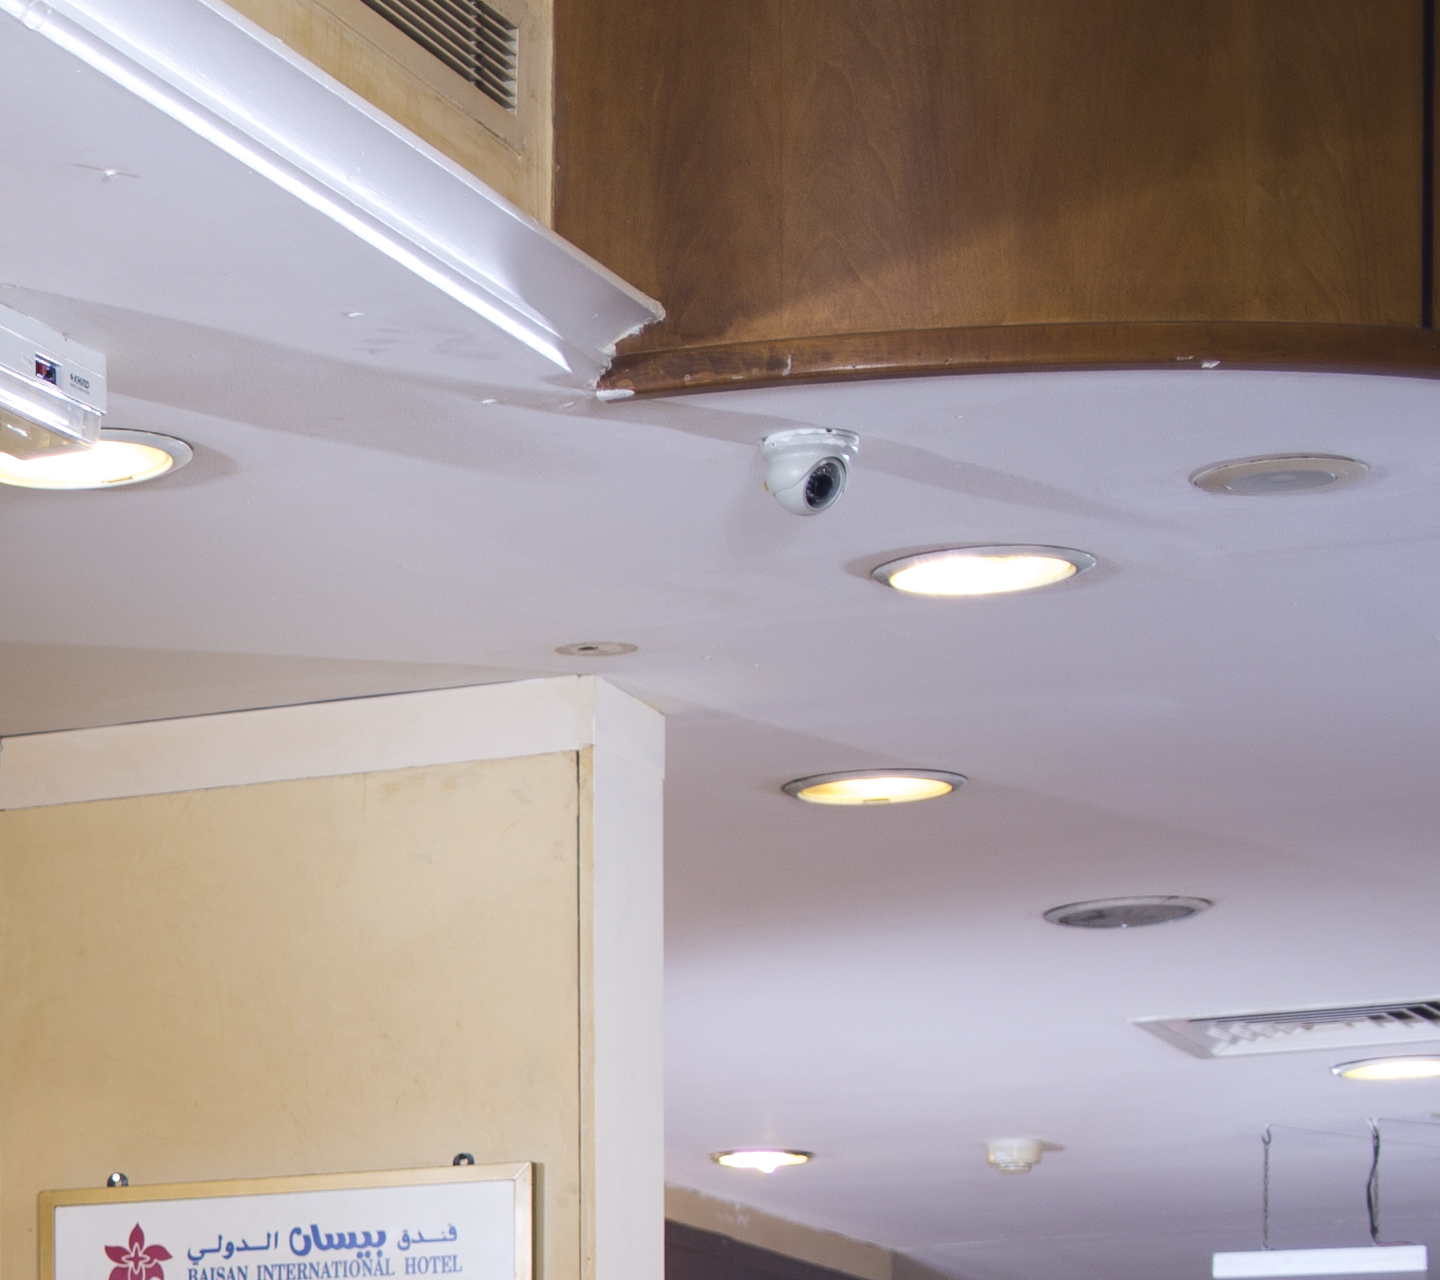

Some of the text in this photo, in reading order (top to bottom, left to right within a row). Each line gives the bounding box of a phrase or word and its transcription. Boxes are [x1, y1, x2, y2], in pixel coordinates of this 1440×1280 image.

[187, 1223, 458, 1266] فندق بيسان الدولي
[404, 1254, 462, 1276] HOTEL
